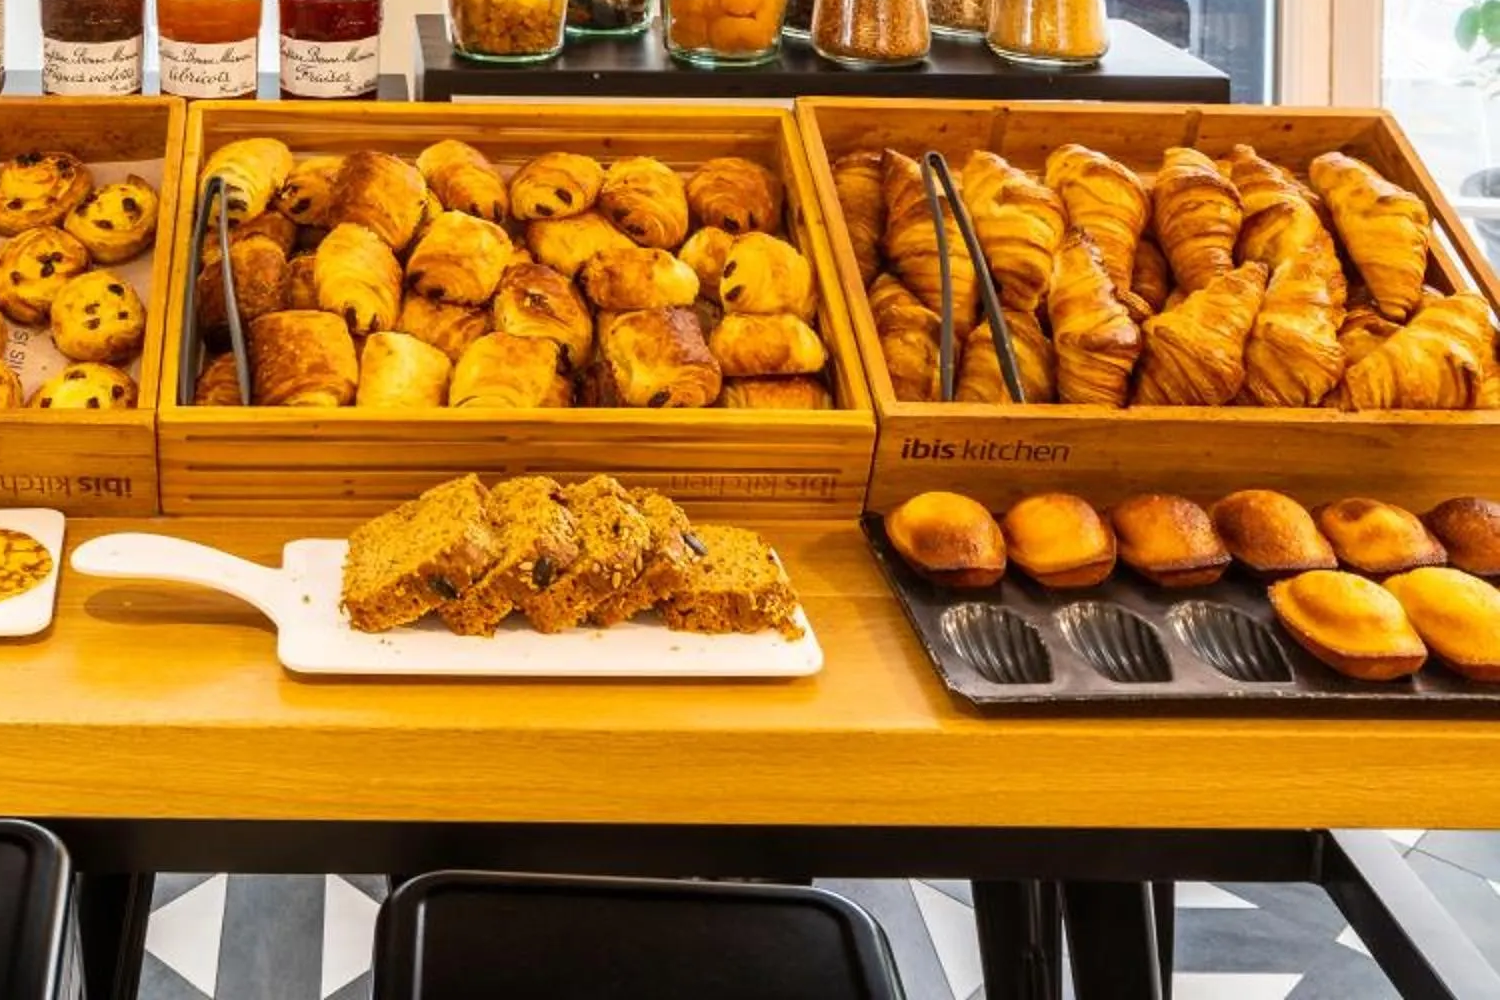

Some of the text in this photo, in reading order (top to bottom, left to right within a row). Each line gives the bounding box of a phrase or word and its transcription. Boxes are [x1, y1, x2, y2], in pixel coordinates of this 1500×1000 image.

[901, 437, 1071, 462] ibis kitchen
[77, 475, 133, 498] ibis
[670, 475, 837, 497] ibis kitchen
